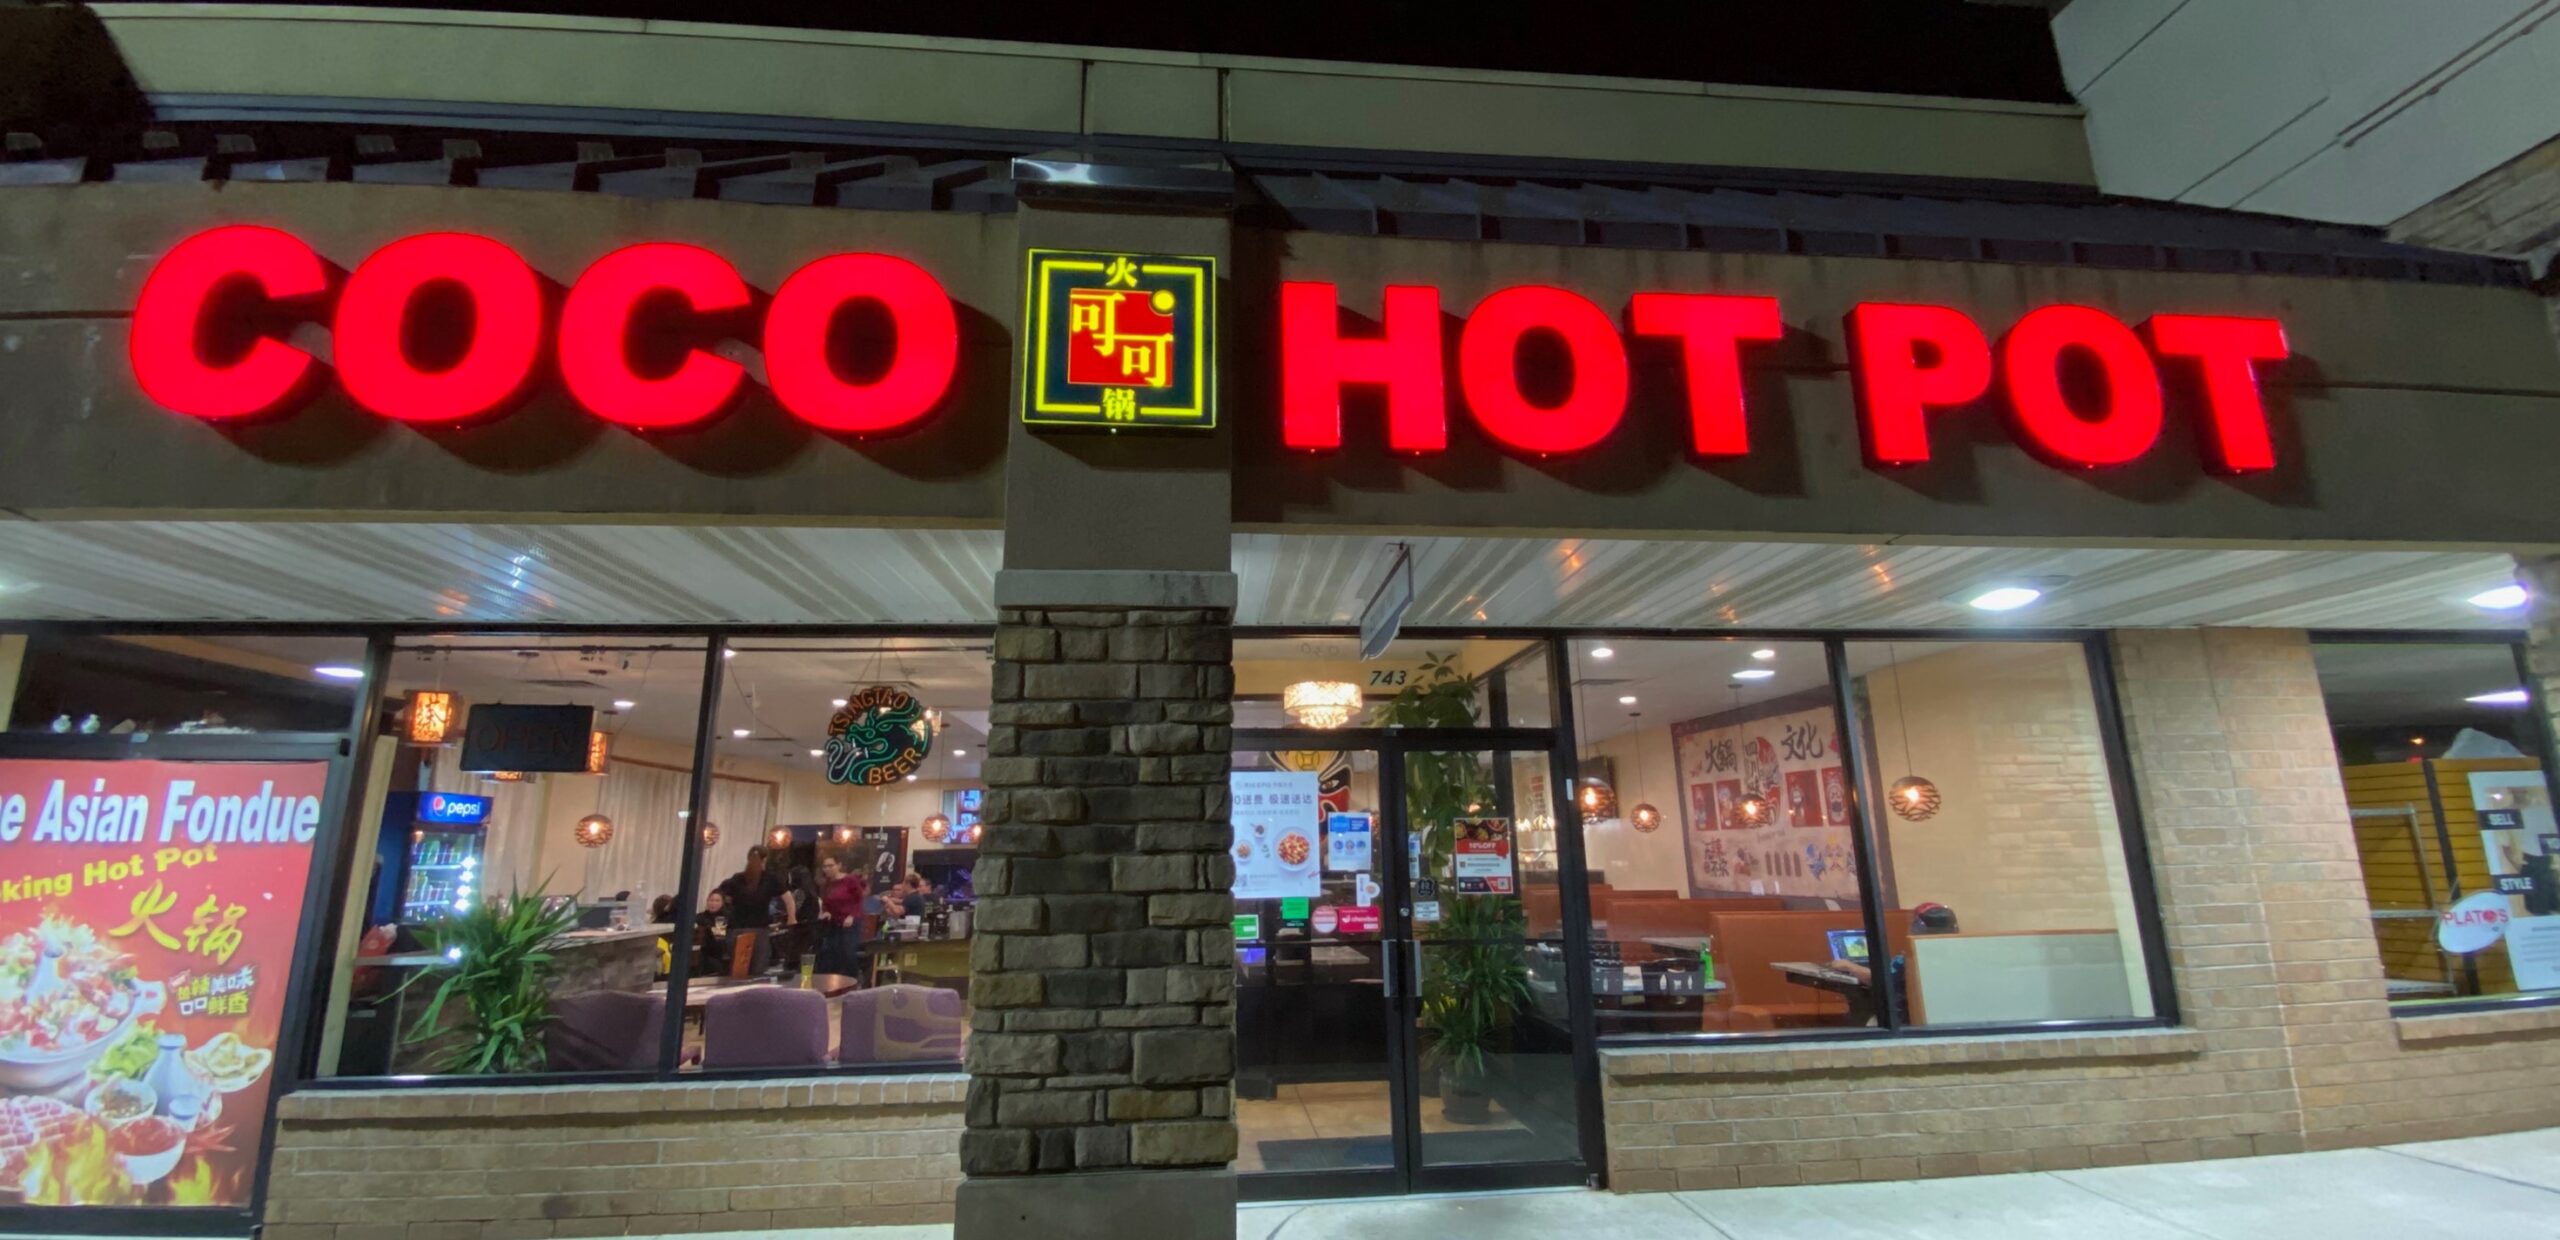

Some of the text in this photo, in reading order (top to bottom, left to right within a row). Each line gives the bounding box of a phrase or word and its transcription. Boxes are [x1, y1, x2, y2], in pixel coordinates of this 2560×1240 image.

[1105, 256, 1138, 287] 火
[129, 224, 2290, 470] COCO HOT POT
[1069, 291, 1174, 387] 可可
[1370, 670, 1407, 686] 743
[827, 685, 911, 737] TSINGTAO
[868, 747, 922, 784] BEER
[32, 777, 149, 843] Asian
[158, 780, 321, 844] Fondue
[447, 801, 481, 818] pepsi
[2488, 813, 2515, 826] SELL
[0, 841, 219, 903] king Hot Pot
[2500, 877, 2534, 891] STYLE
[108, 878, 248, 966] 火锅
